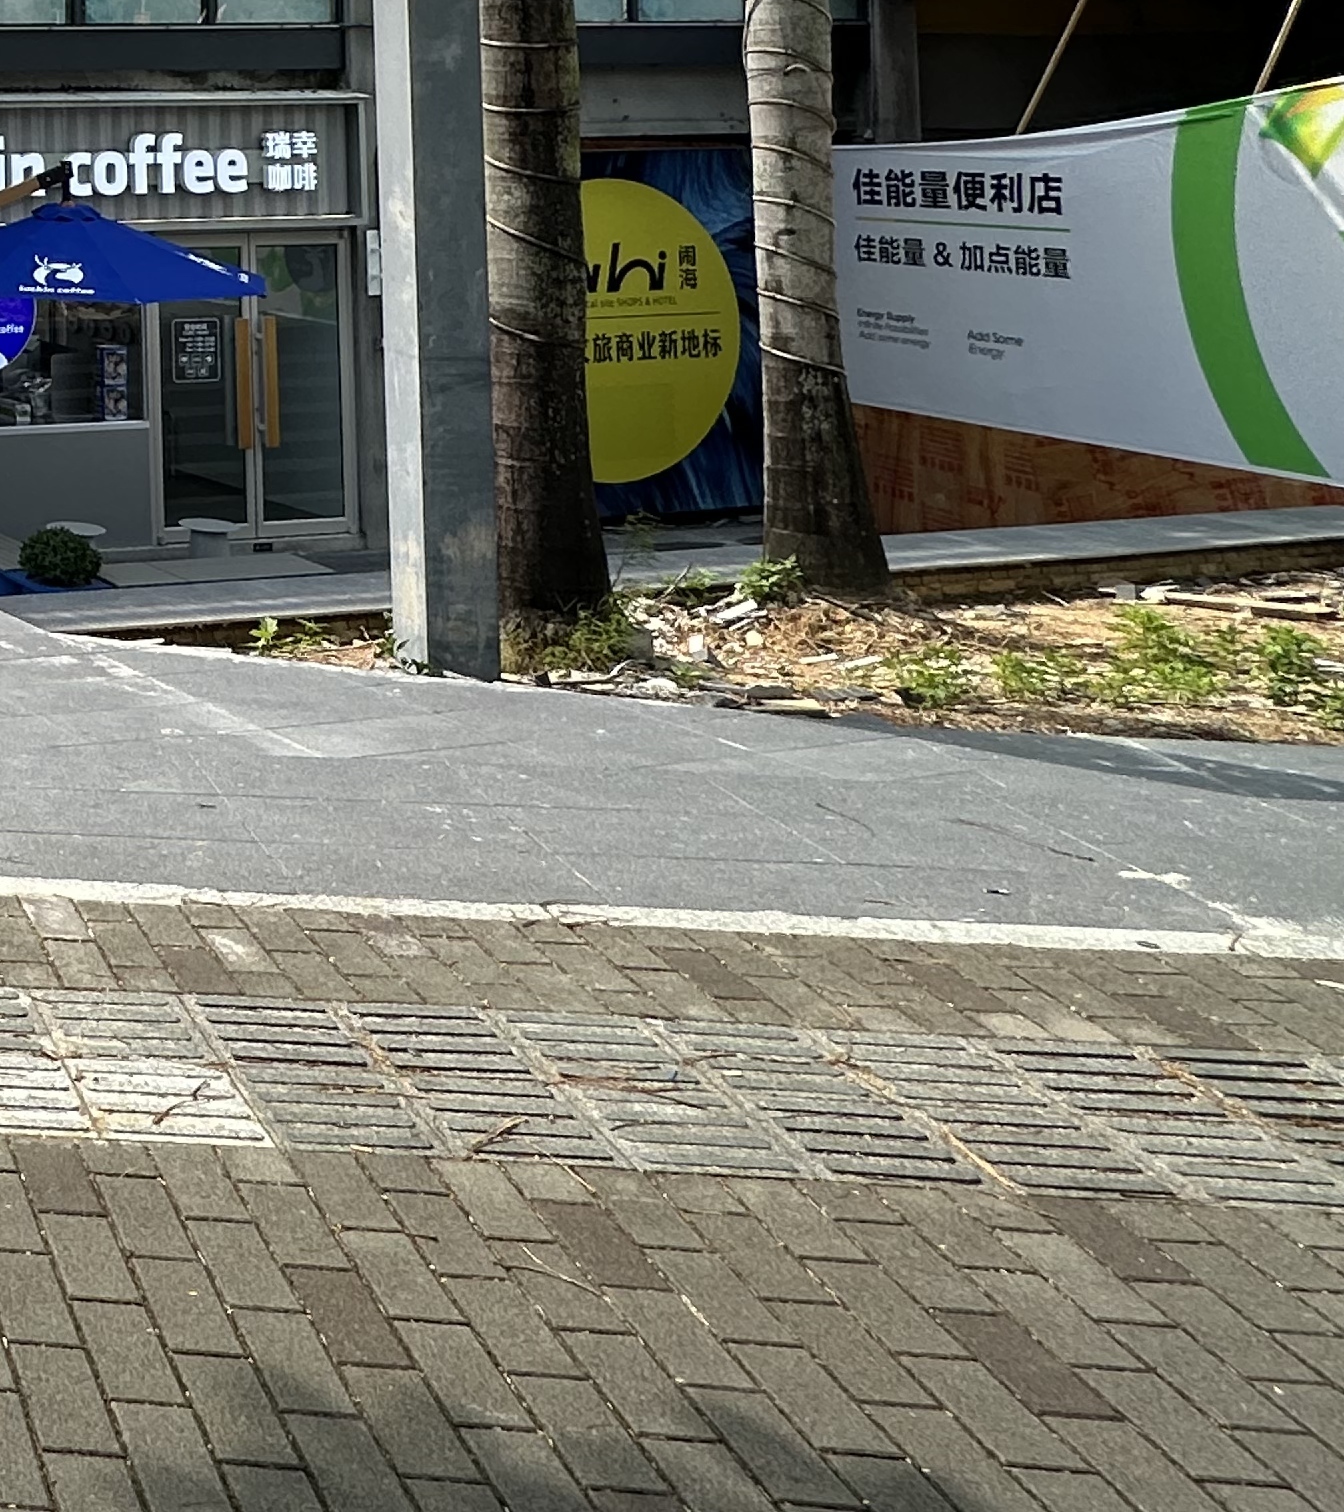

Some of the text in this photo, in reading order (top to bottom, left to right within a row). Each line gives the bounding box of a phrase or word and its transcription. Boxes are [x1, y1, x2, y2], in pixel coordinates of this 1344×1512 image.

[67, 132, 249, 197] coffee
[263, 130, 318, 159] 瑞幸
[263, 162, 318, 192] 咖啡
[852, 168, 1063, 215] 佳能量便利店
[606, 242, 667, 293] hi
[678, 244, 698, 290] 闹海
[854, 234, 1071, 279] 佳能量 & 加点能量
